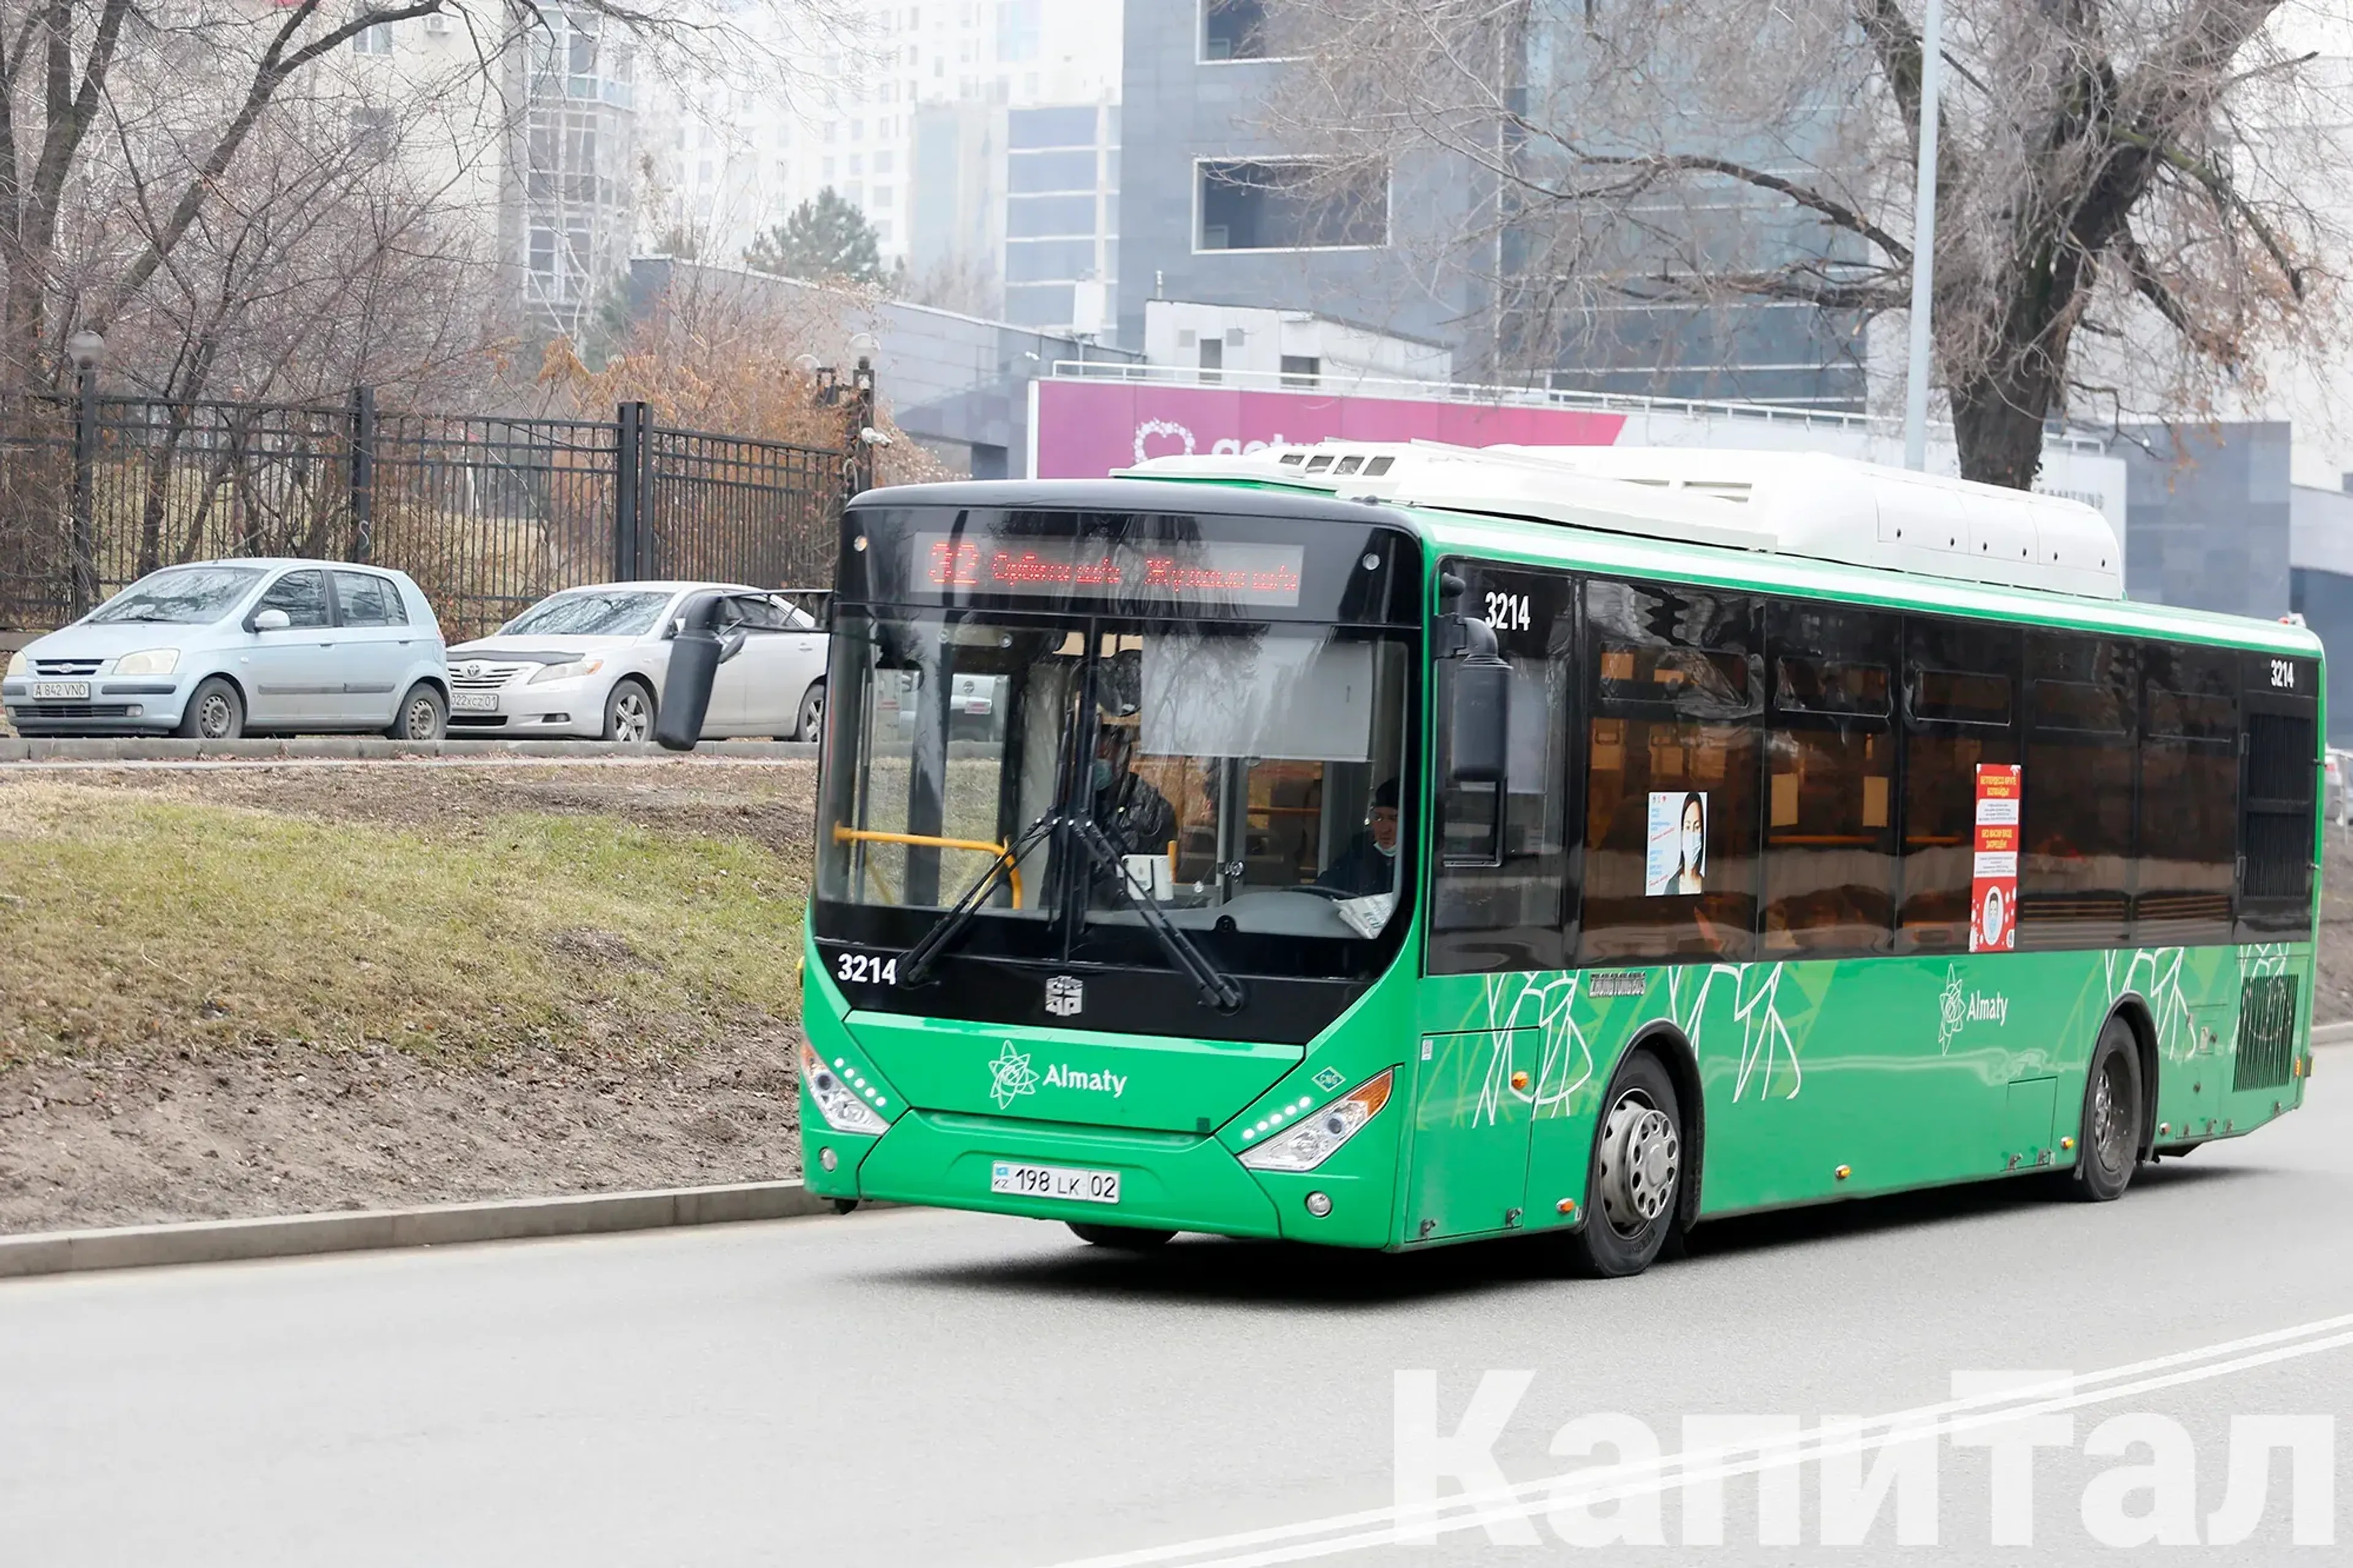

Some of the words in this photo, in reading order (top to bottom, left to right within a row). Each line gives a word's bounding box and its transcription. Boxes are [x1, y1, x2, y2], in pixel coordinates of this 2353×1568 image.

[1485, 591, 1531, 631] 3214
[2271, 659, 2294, 688] 3214
[36, 685, 42, 696] A
[45, 684, 61, 696] 842
[838, 953, 896, 985] 3214
[1966, 990, 2009, 1026] Almaty
[1042, 1063, 1127, 1098] Almaty
[1015, 1168, 1050, 1192] 198
[1057, 1177, 1080, 1195] LK
[1091, 1175, 1116, 1198] 02
